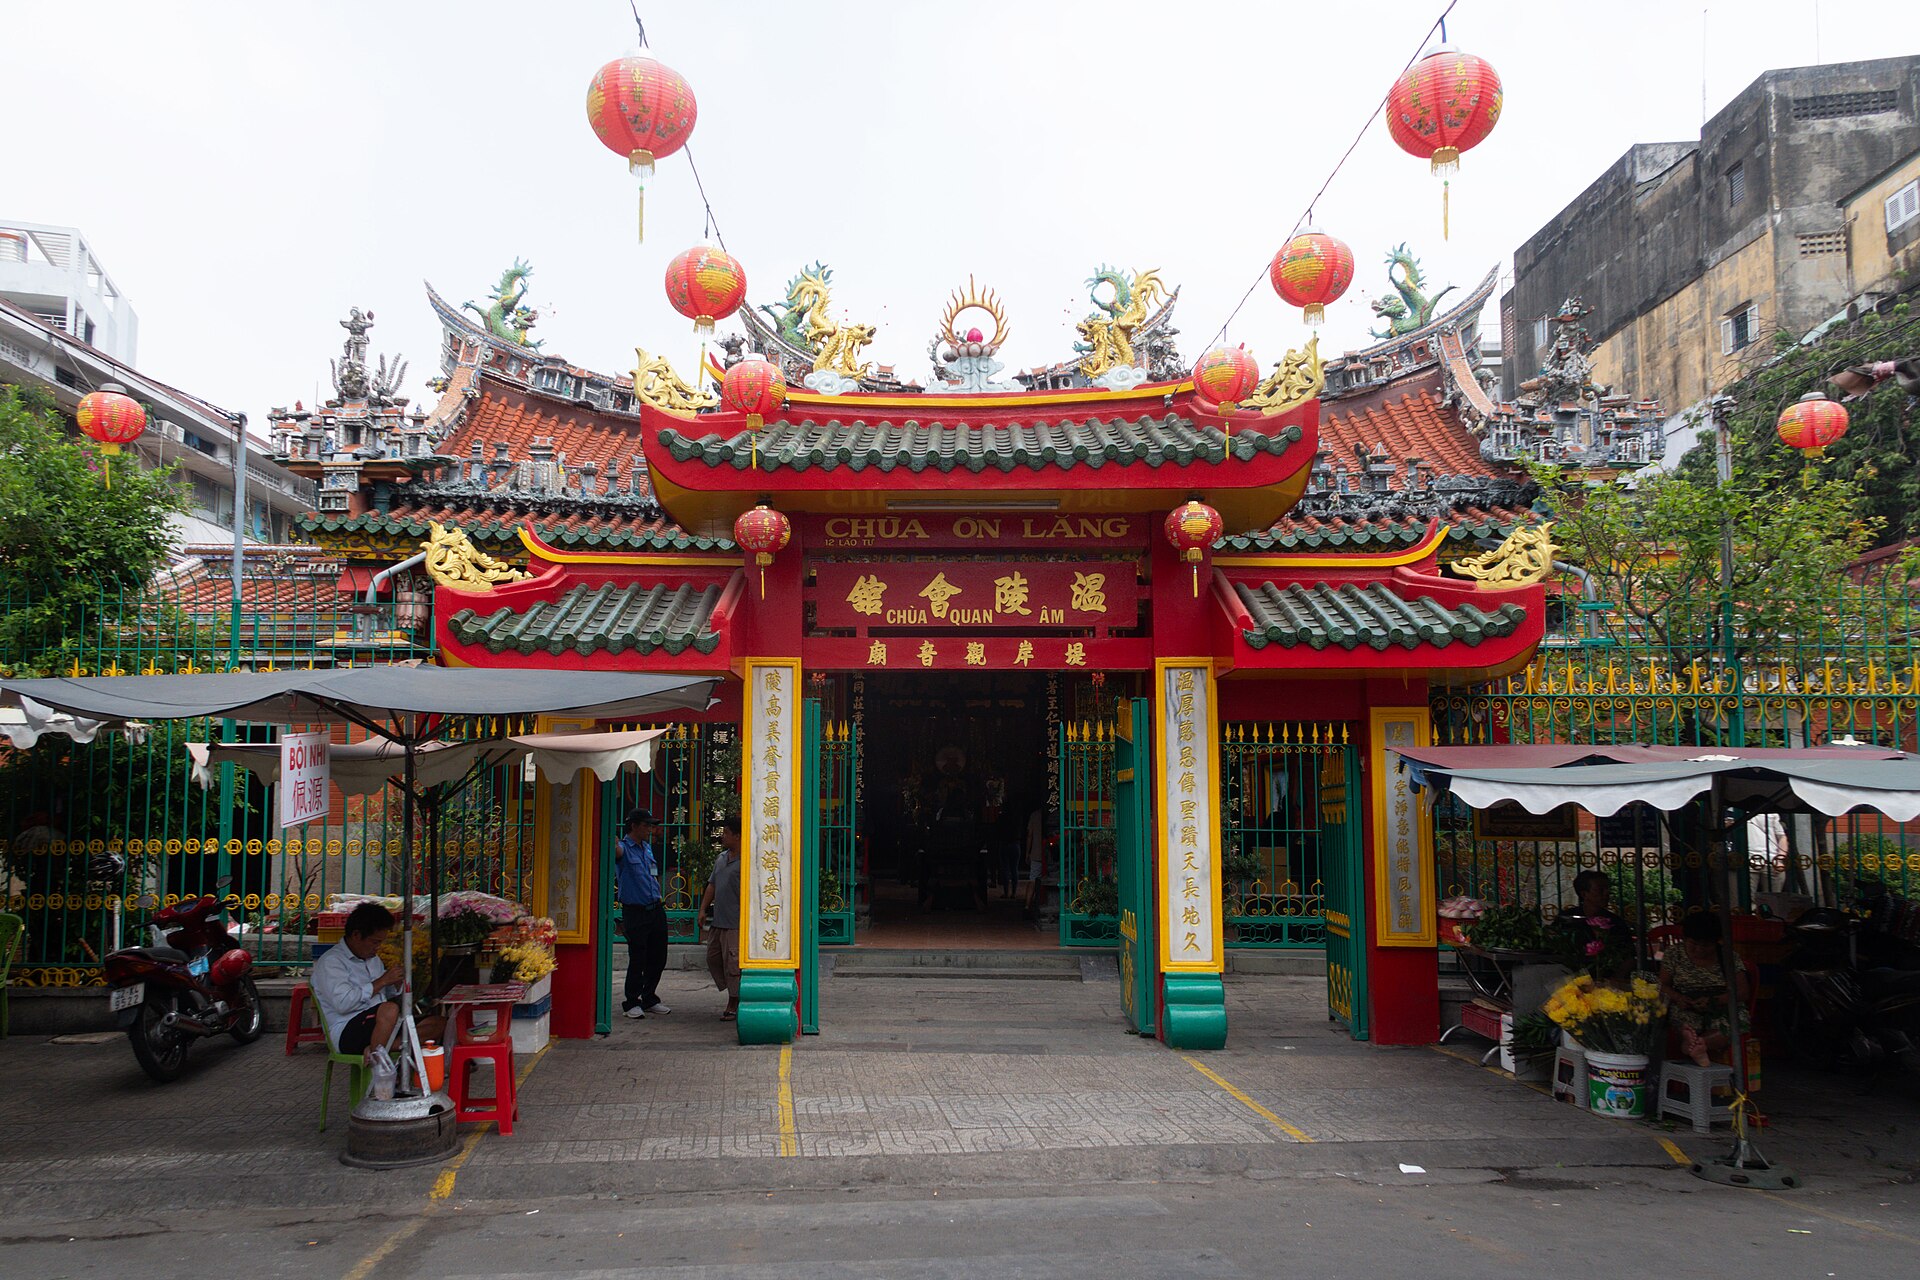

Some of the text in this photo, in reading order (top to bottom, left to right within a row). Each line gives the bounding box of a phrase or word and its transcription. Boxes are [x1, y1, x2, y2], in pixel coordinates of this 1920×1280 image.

[1022, 512, 1131, 539] LĂNG
[824, 539, 835, 547] 12
[886, 605, 1065, 626] CHÙA QUAN ÂM
[289, 740, 326, 776] BỘI NHI
